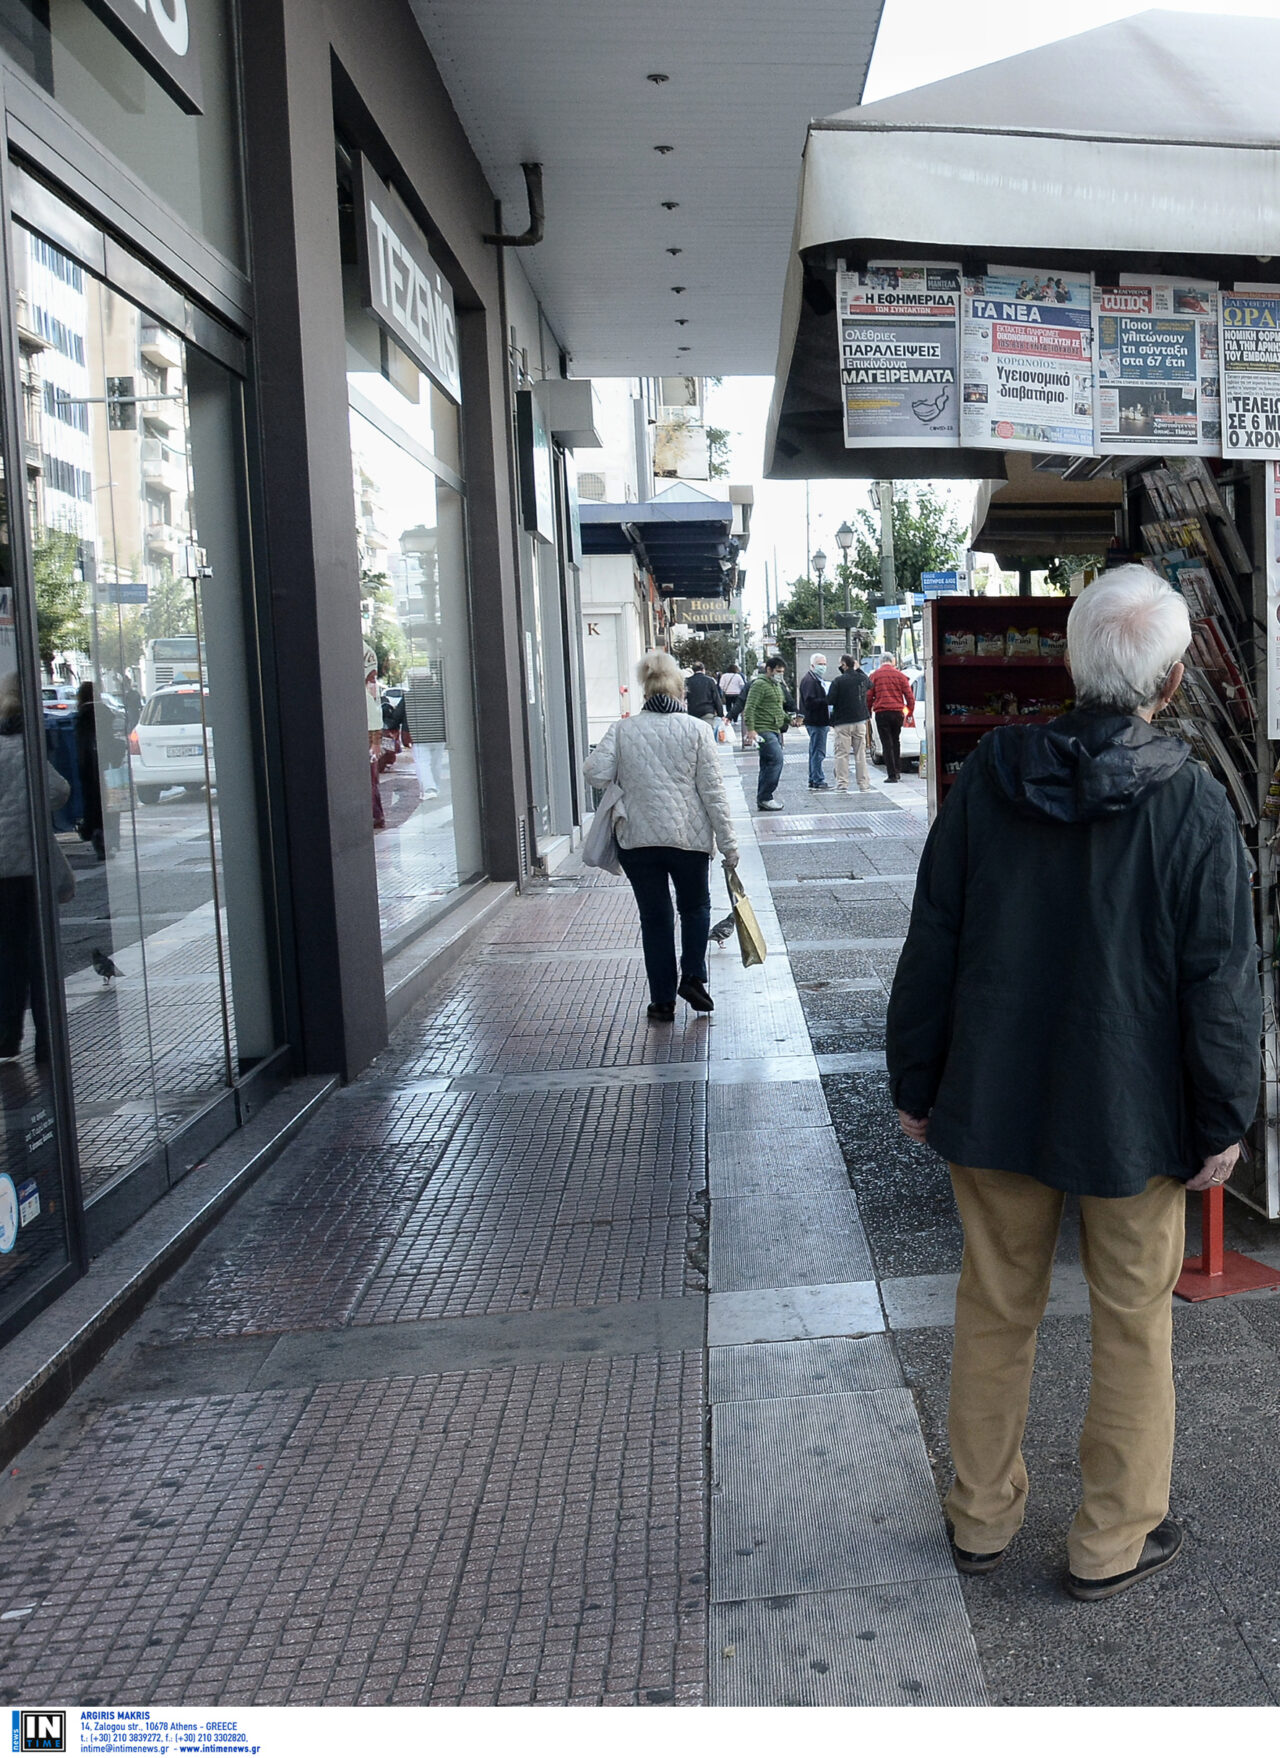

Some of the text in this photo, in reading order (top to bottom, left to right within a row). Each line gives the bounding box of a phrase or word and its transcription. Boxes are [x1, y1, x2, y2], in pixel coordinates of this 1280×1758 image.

[865, 293, 955, 306] Η ΕΦΗΜΕΡΙΔΑ
[875, 305, 931, 314] ΤΩΝ ΣΥΝΤΑΚΤΩΝ
[974, 301, 1042, 323] ΤΑ ΝΕΑ
[1121, 318, 1152, 330] Ποιοι
[1223, 307, 1276, 328] ΩΡΑ
[845, 329, 897, 343] Ολέθριες
[1121, 331, 1185, 344] γλιτώνουν
[1224, 330, 1257, 341] ΝΟΜΙΚΗ
[842, 344, 940, 358] ΠΑΡΑΛΕΙΨΕΙΣ
[1121, 344, 1188, 358] τη σύνταξη
[1224, 340, 1238, 351] ΓΙΑ
[1239, 341, 1256, 351] ΤΗΝ
[1122, 356, 1186, 367] στα 67 έτη
[1224, 351, 1241, 361] ΤΟΥ
[846, 358, 908, 369] Επικίνδυνα
[842, 368, 955, 384] ΜΑΓΕΙΡΕΜΑΤΑ
[996, 366, 1071, 387] Υγειονομικό
[1228, 413, 1247, 430] ΣΕ
[1251, 414, 1260, 430] 6
[1229, 430, 1240, 447] Ο
[691, 600, 728, 611] Hotel
